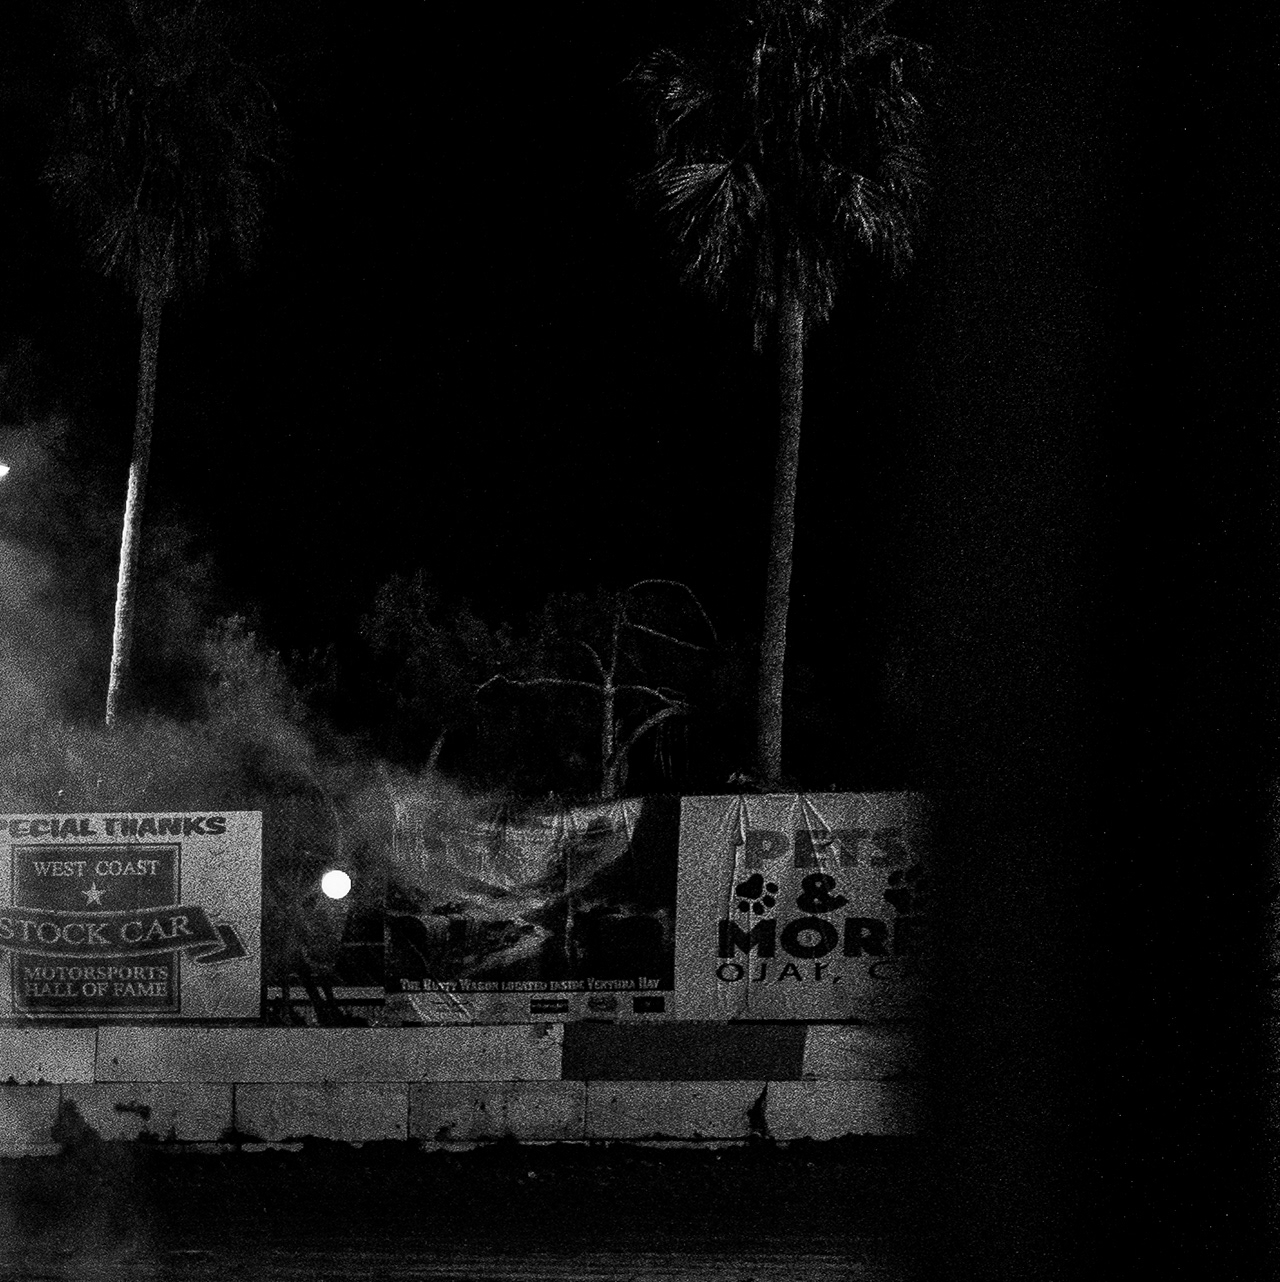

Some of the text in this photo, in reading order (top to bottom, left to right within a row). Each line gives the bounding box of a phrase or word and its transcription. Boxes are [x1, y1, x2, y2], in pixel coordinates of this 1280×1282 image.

[103, 816, 227, 837] THANKS
[33, 860, 159, 877] WEST COAST
[796, 873, 849, 914] &
[120, 915, 194, 942] CAR
[24, 965, 169, 981] MOTORSPORTS
[24, 981, 168, 998] HALL OF FAME
